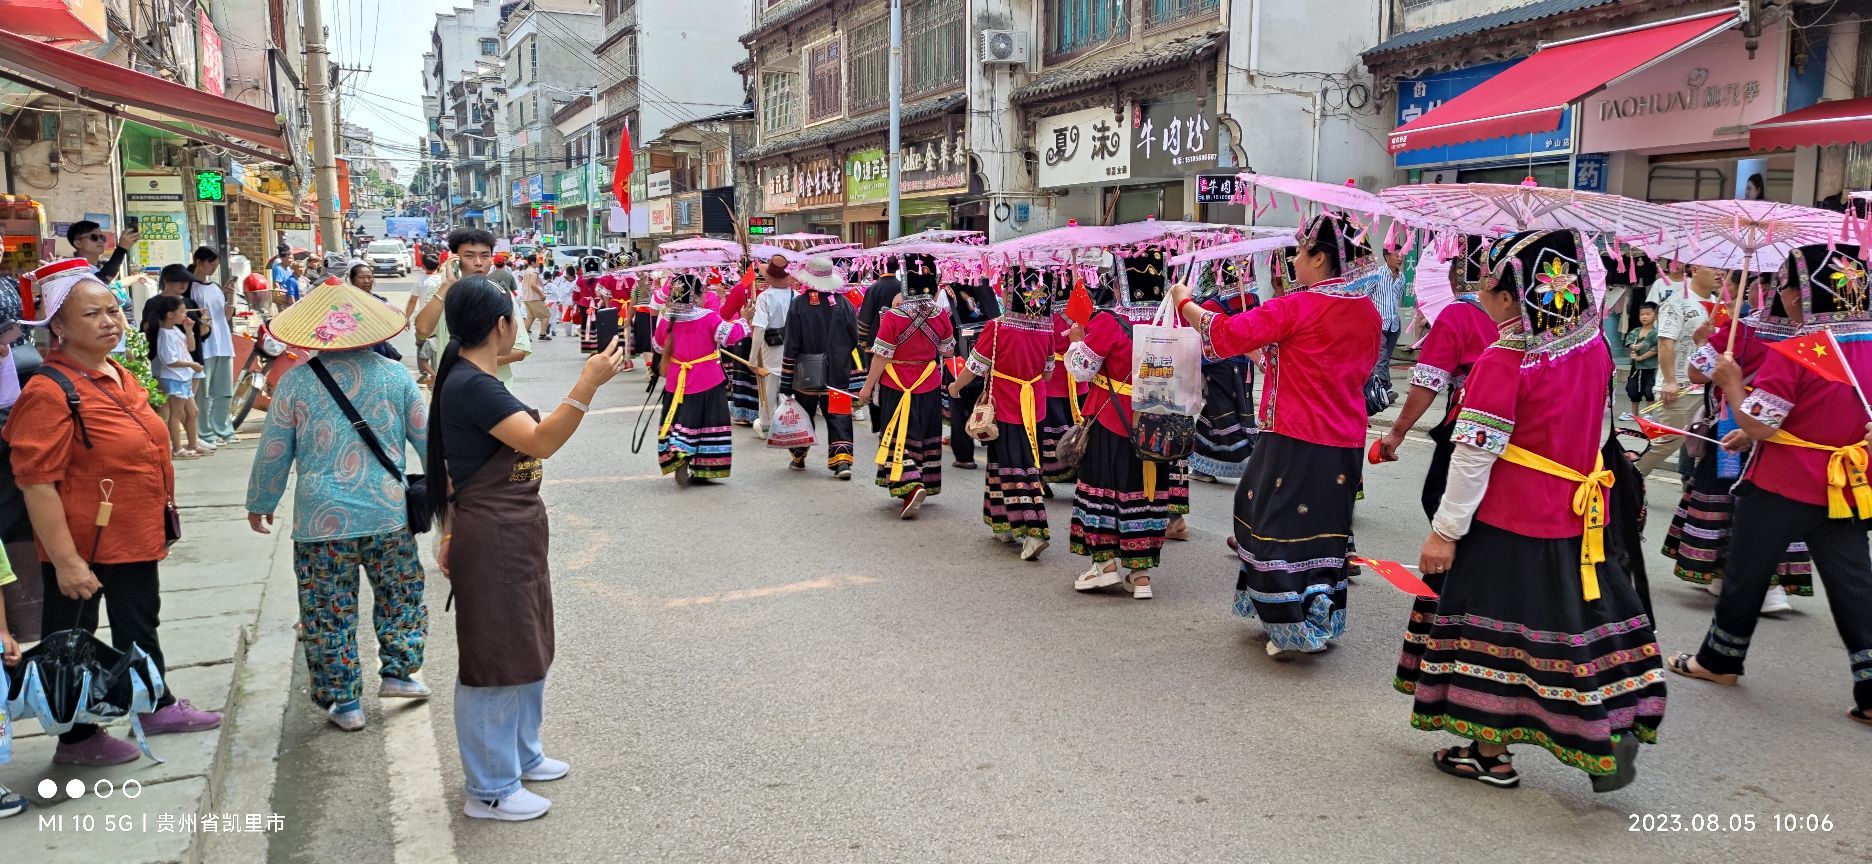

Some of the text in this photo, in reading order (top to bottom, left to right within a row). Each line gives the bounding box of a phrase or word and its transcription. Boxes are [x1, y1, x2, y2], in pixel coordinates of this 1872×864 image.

[1136, 114, 1210, 159] 牛肉粉
[197, 173, 222, 200] 药
[1578, 160, 1600, 188] 药
